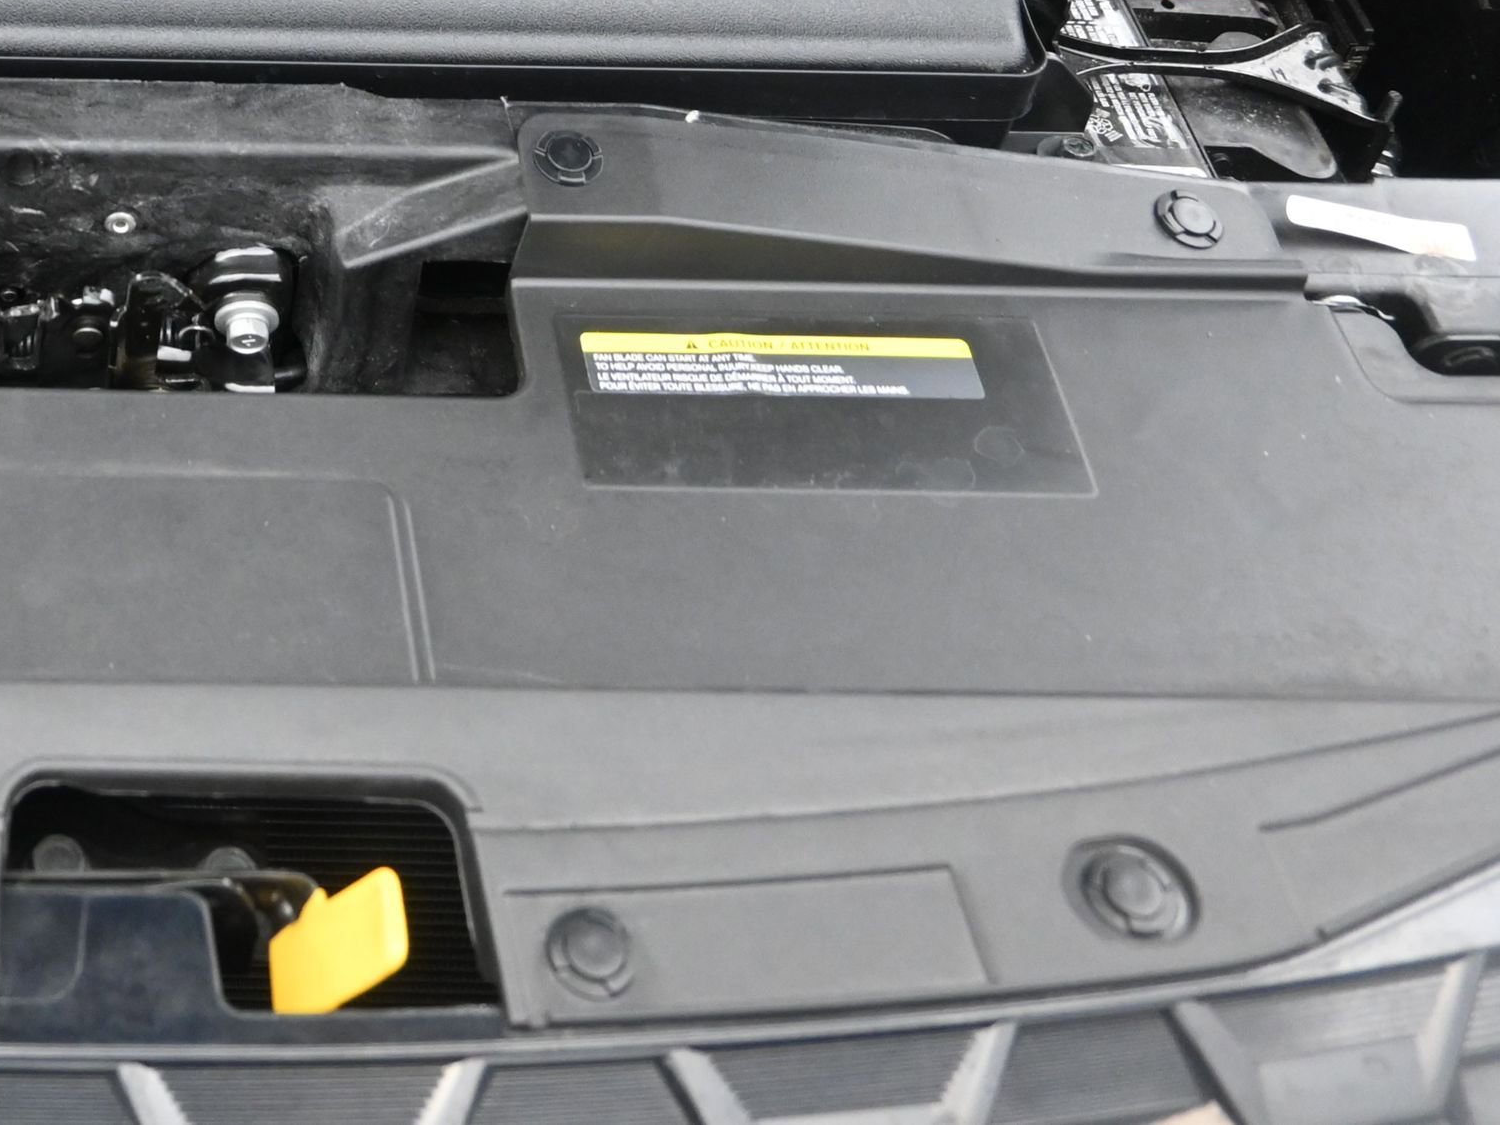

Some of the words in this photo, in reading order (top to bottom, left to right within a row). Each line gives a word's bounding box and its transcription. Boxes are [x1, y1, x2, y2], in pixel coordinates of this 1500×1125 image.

[708, 339, 774, 349] CAUTION
[790, 341, 870, 352] ATTENTION
[593, 353, 612, 361] FAN
[613, 353, 644, 362] BLADE
[645, 354, 666, 362] CAN
[667, 354, 696, 362] START
[699, 354, 709, 362] AT
[711, 354, 731, 362] ANY
[595, 362, 609, 371] TO
[610, 363, 635, 371] HELP
[636, 363, 665, 371] AVOID
[666, 363, 717, 372] PERSONAL
[775, 364, 810, 373] HANDS
[597, 372, 610, 381] LE
[710, 373, 724, 382] DE
[786, 375, 810, 384] TOUT
[599, 382, 628, 390] POUR
[662, 382, 693, 391] TOUTE
